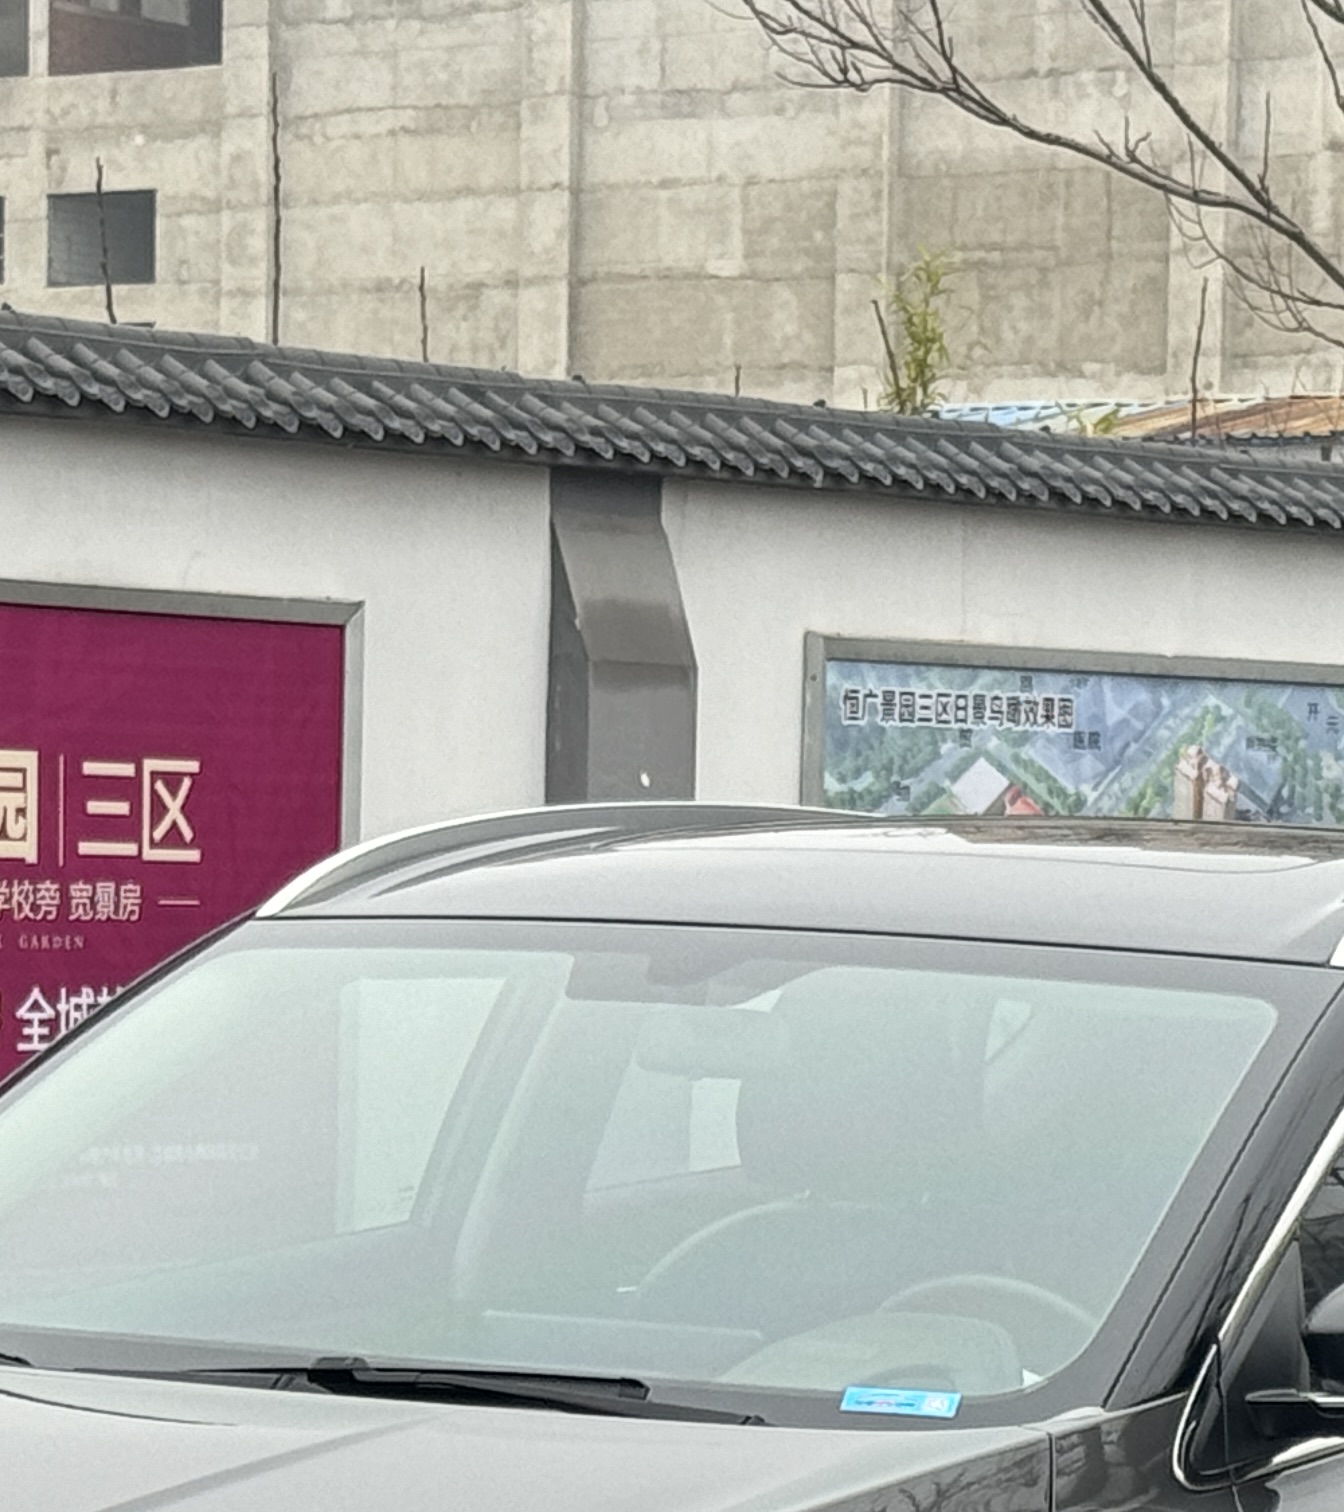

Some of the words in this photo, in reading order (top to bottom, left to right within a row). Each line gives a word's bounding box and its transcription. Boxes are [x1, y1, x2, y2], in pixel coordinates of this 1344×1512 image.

[77, 756, 202, 863] 三区
[68, 879, 142, 922] 宽景房
[18, 933, 85, 951] GARDEN
